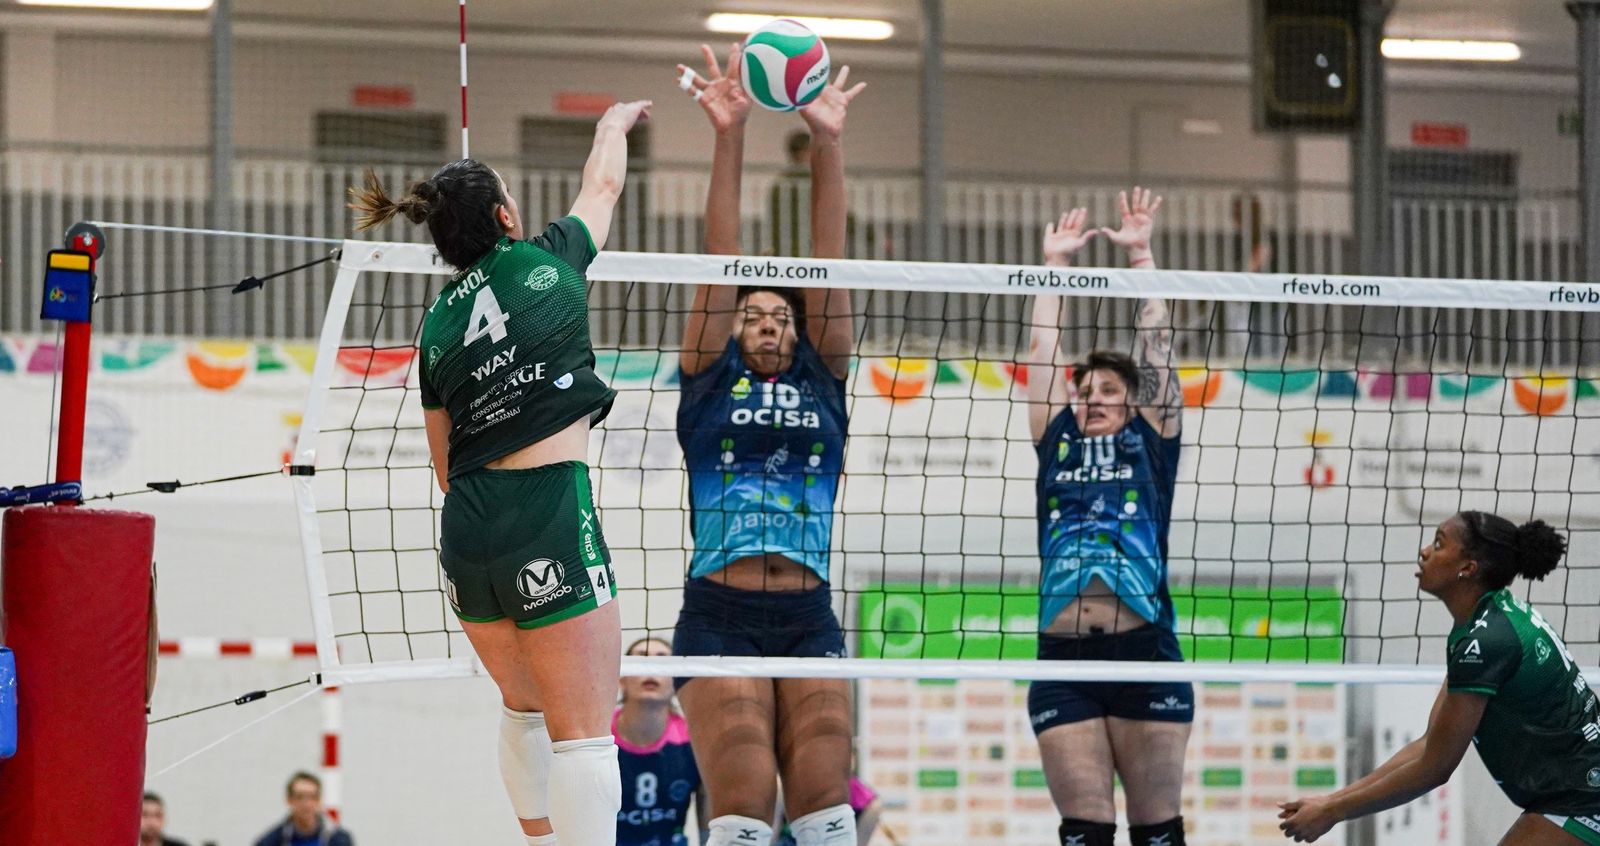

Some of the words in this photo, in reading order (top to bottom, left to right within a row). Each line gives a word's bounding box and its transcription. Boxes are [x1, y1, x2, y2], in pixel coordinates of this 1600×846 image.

[723, 260, 828, 280] rfevb.com
[1007, 268, 1109, 289] rfevb.com
[1282, 278, 1381, 297] rfevb.com
[463, 285, 510, 347] 4
[471, 345, 517, 381] WAY
[730, 408, 820, 429] ocisa
[597, 571, 606, 590] 4
[636, 772, 658, 808] 8
